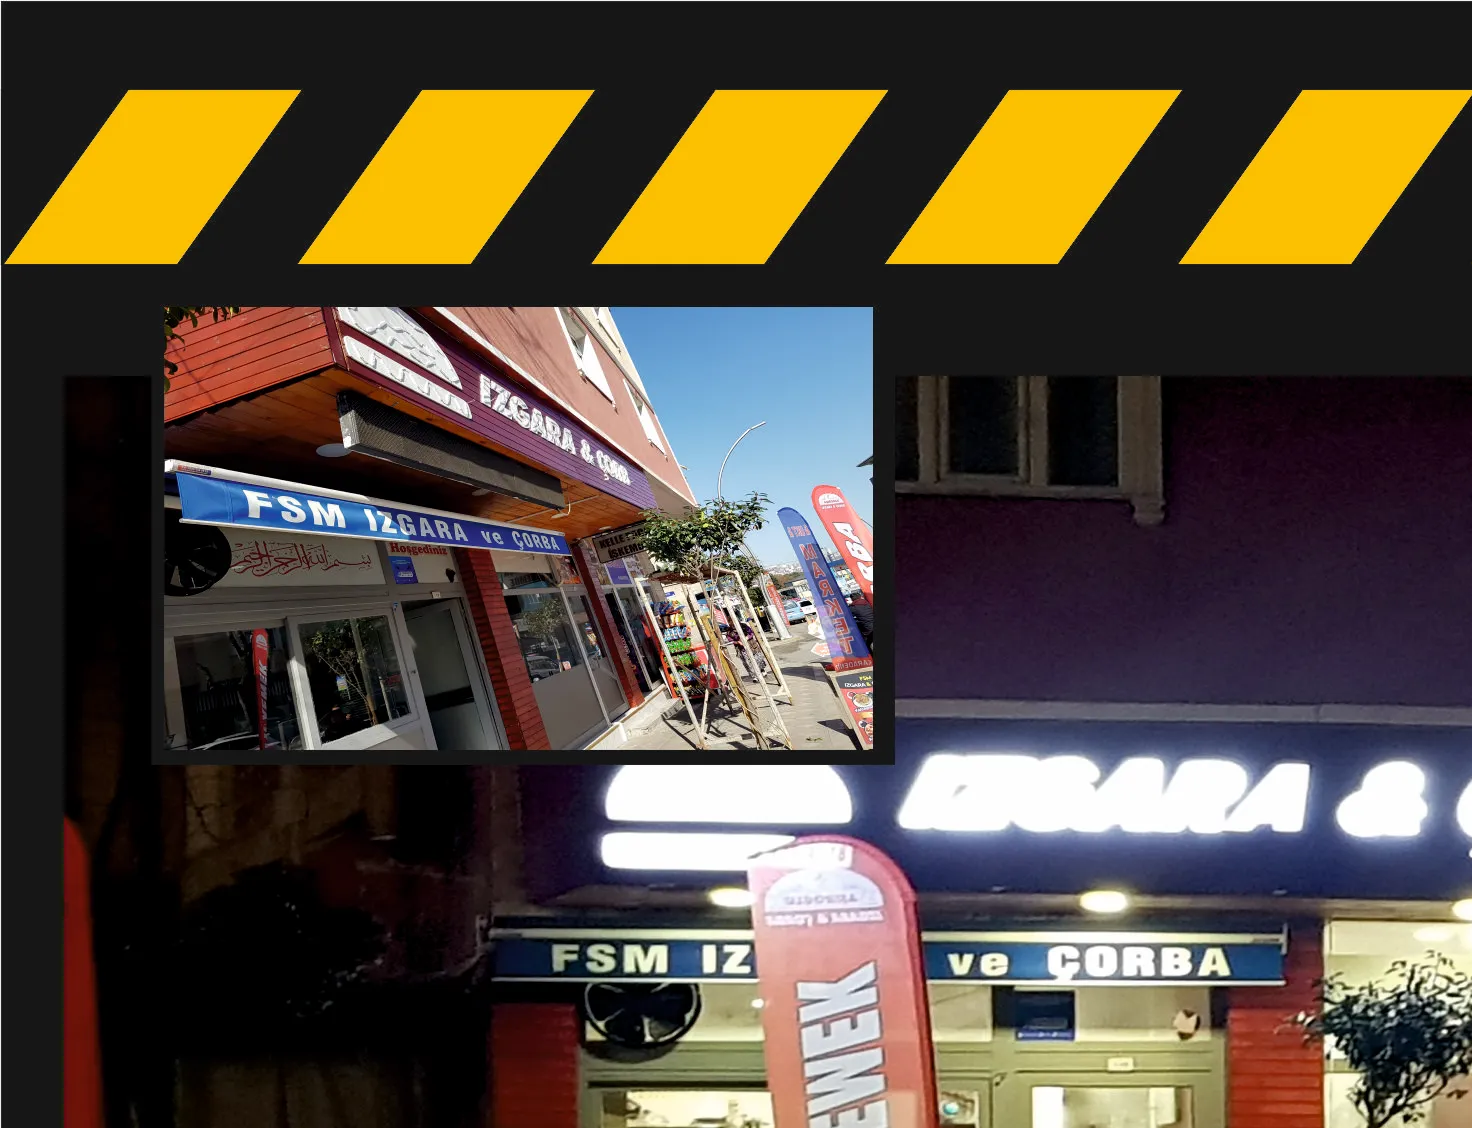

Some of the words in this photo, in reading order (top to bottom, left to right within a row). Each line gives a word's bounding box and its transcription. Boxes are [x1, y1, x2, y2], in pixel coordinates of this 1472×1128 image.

[479, 373, 577, 456] IZGARA
[242, 489, 346, 529] FSM
[363, 508, 469, 542] IZGARA
[480, 530, 504, 545] ve
[511, 530, 561, 551] ÇORBA
[551, 944, 669, 974] FSM
[947, 949, 1009, 976] ve
[1047, 945, 1231, 978] ÇORBA
